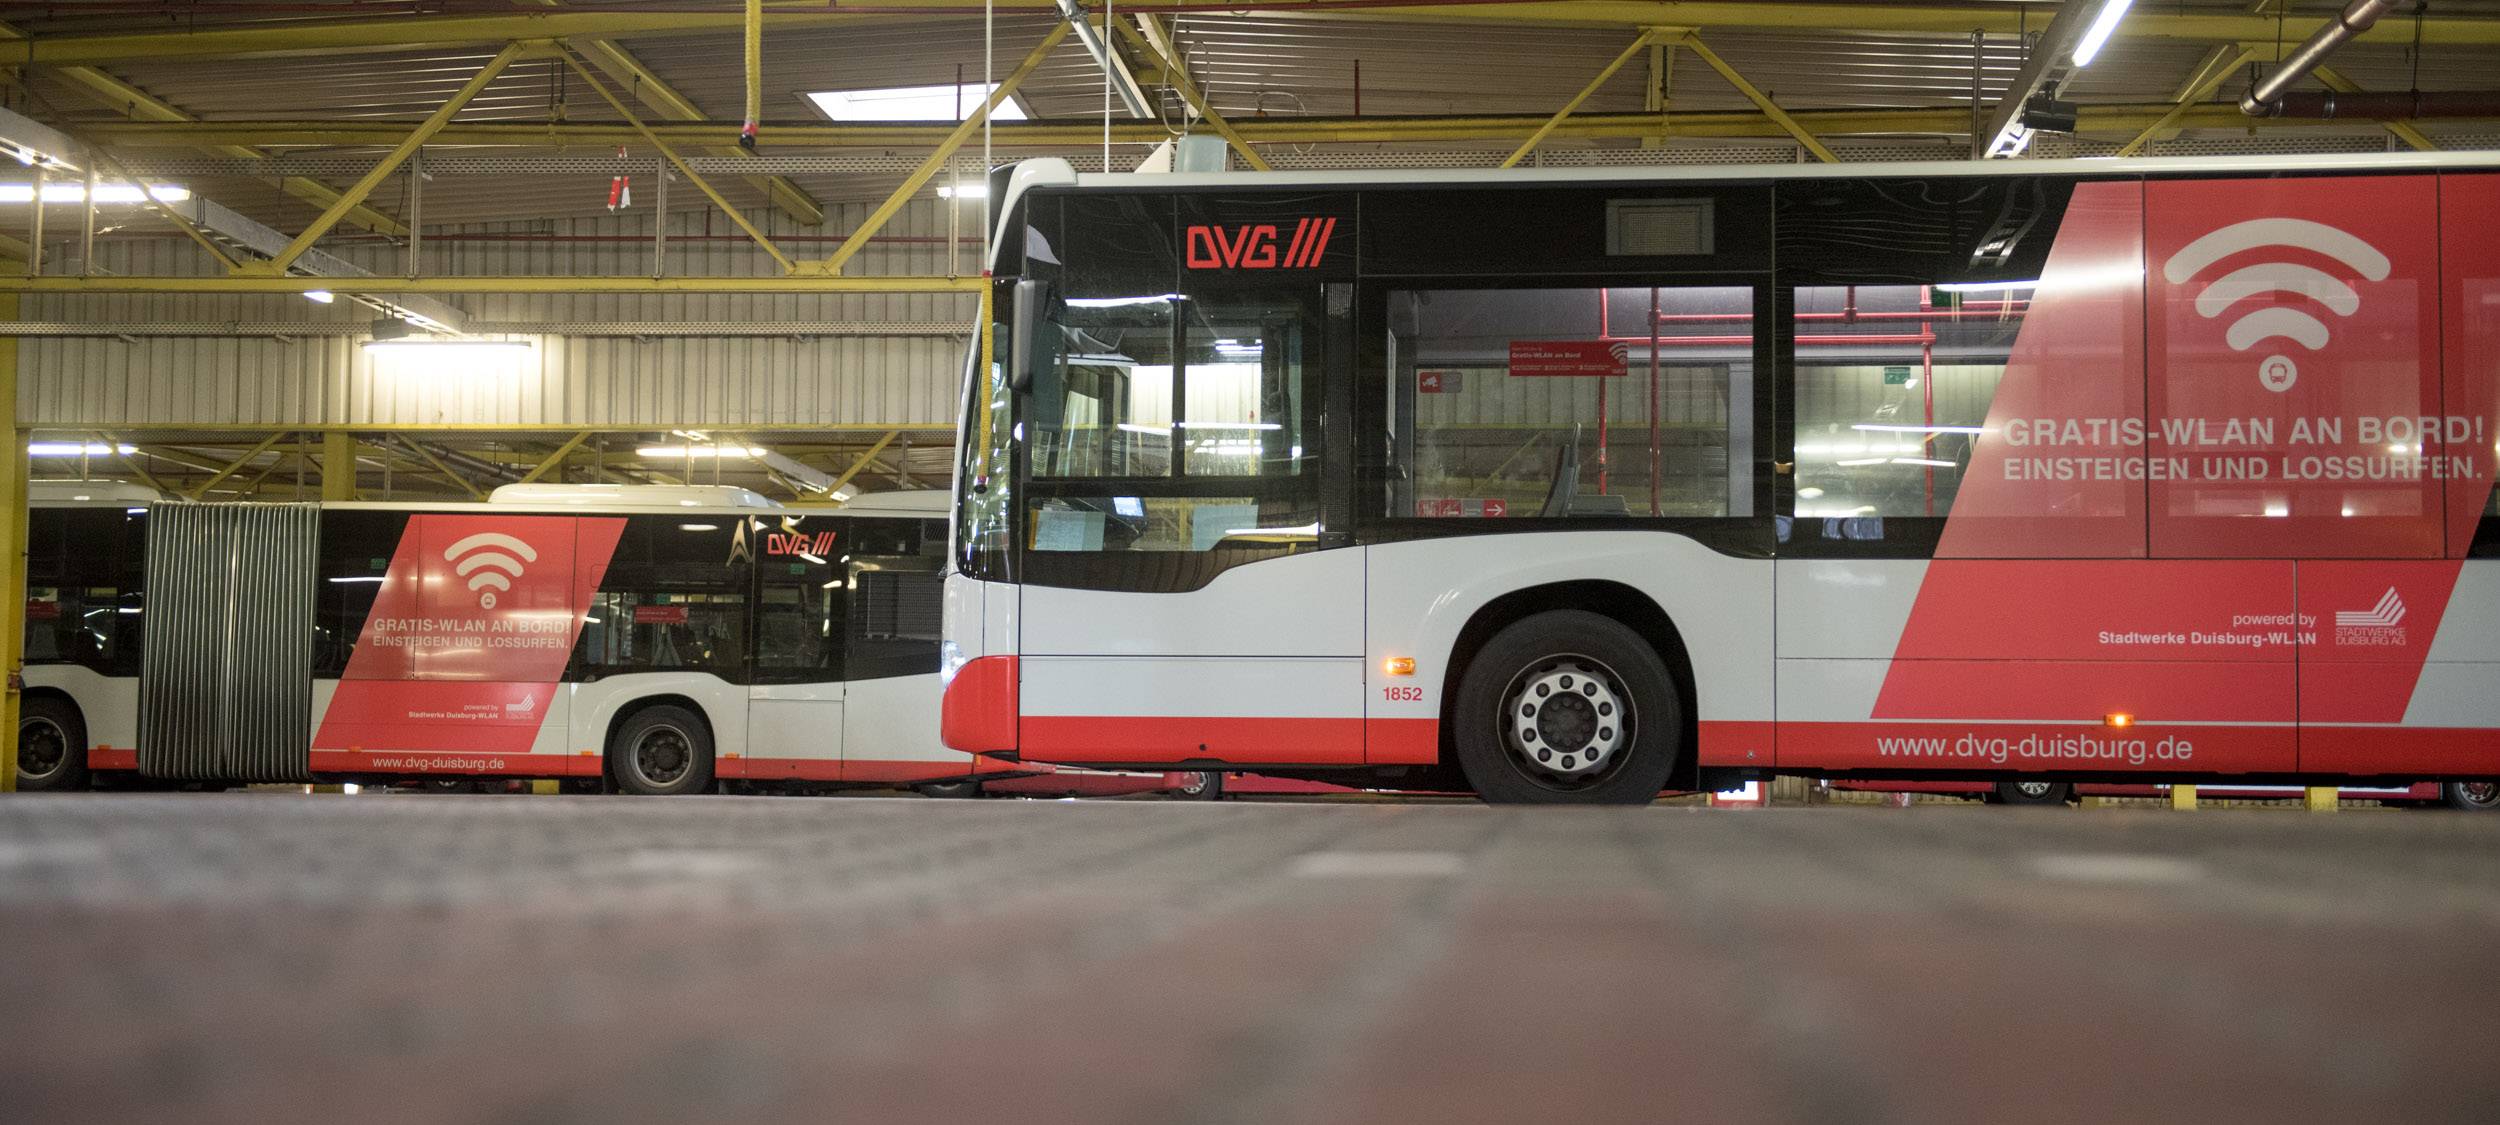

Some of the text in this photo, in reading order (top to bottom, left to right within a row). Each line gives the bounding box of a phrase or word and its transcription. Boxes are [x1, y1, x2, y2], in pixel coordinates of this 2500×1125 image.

[2002, 415, 2483, 447] GRATIS-WLAN AN BORD!
[2003, 455, 2483, 480] EINSTEIGEN UND LOSSURFEN.
[373, 618, 571, 634] GRATIS-WLAN AN BORD!
[2232, 613, 2317, 628] powered by
[2098, 631, 2317, 648] Stadtwerke Duisburg-WLAN
[2335, 627, 2406, 637] STADTWERKE
[372, 635, 569, 649] EINSTEIGEN UND LOSSURFEN.
[2335, 636, 2406, 646] DUISBURG AG
[1383, 687, 1423, 701] 1852
[408, 711, 445, 719] Stadtwerke
[446, 711, 499, 721] Duisburg-WLAN
[1876, 732, 2193, 765] www.dvg-duisburg.de
[372, 756, 505, 771] www.dvg-duisburg.de
